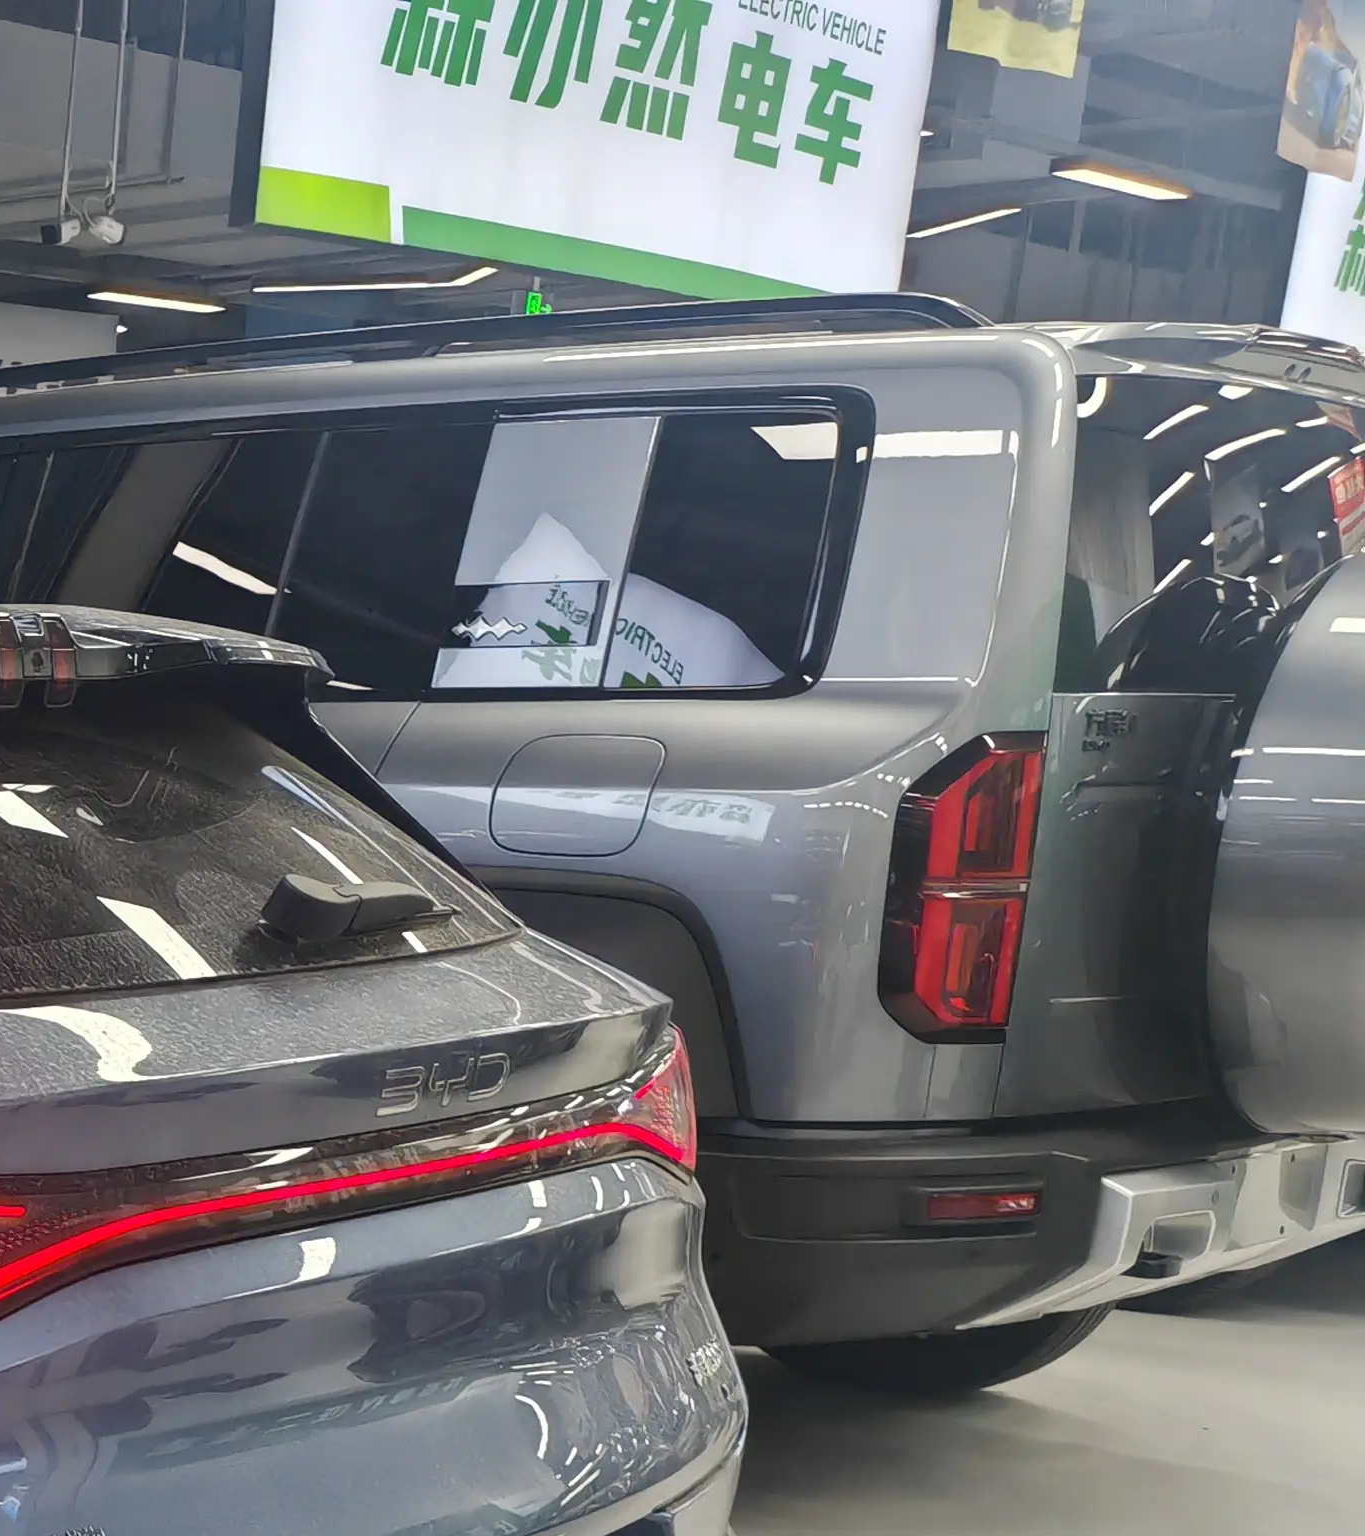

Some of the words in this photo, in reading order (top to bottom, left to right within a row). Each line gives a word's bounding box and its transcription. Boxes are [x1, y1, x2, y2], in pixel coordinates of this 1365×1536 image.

[822, 7, 887, 55] VEHICLE
[717, 30, 874, 185] 电车
[376, 1052, 511, 1118] BYD
